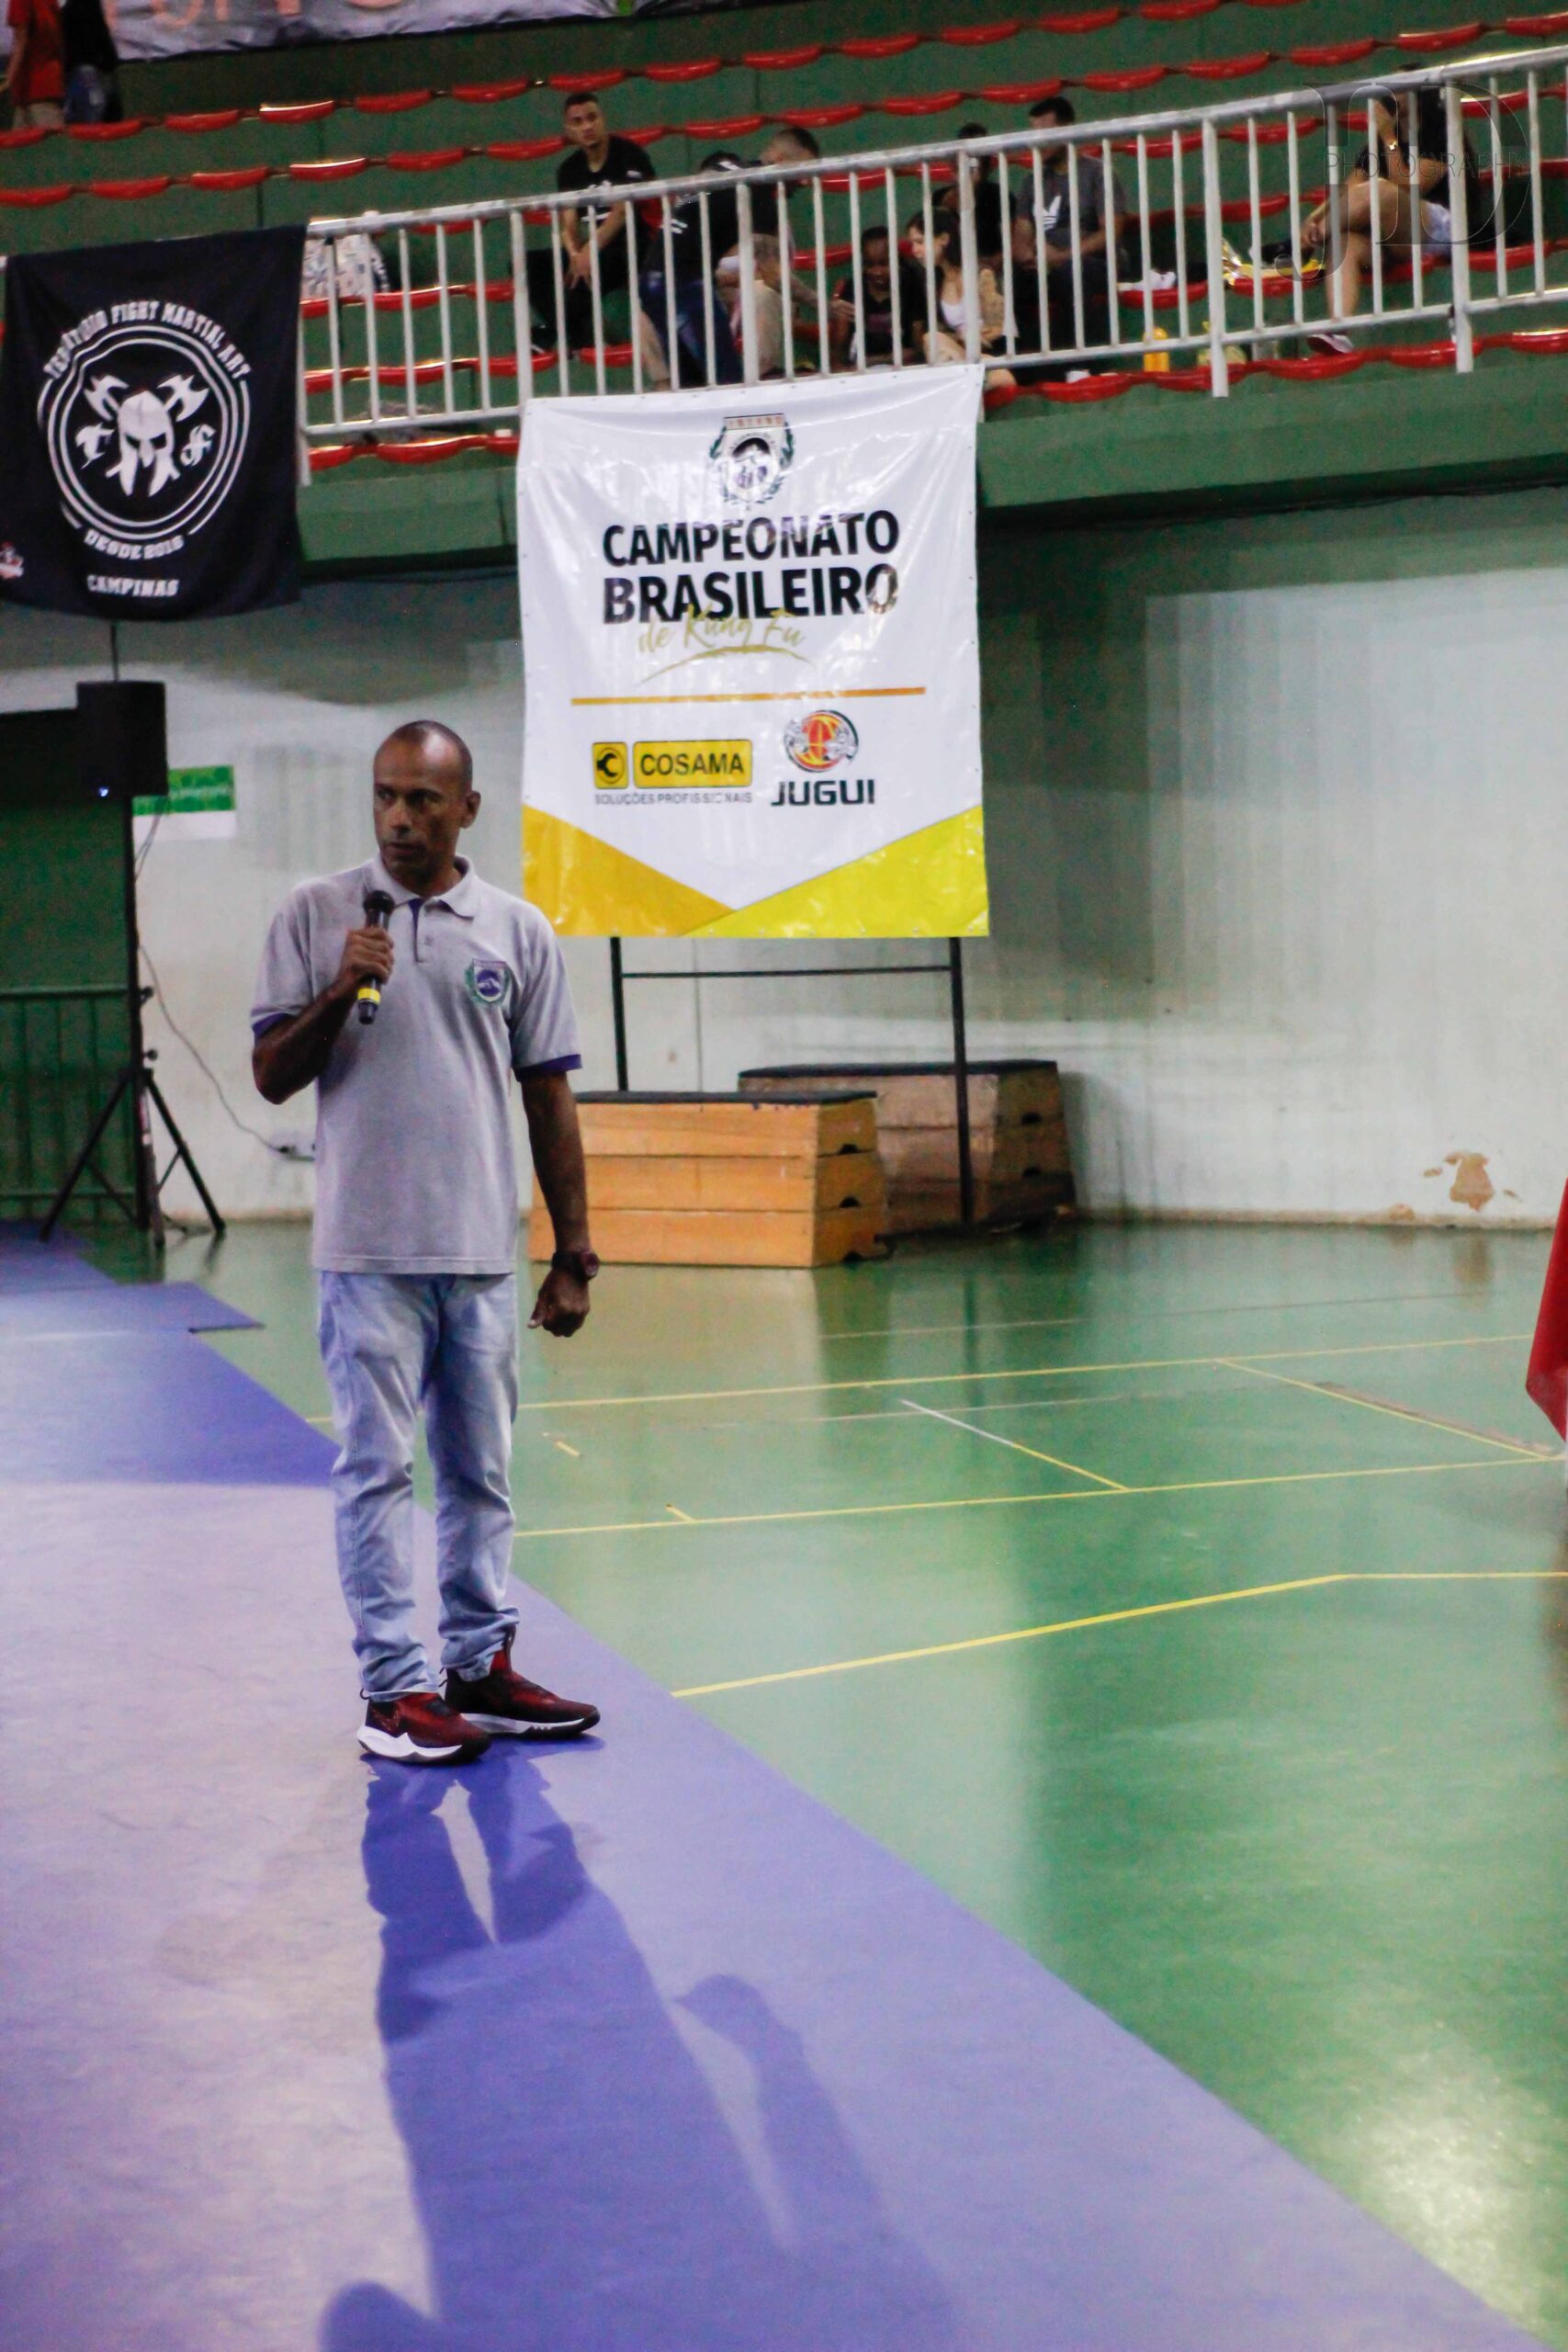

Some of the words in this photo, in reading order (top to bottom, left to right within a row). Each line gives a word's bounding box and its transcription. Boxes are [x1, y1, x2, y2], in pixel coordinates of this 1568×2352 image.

[110, 300, 160, 324] FIGHT
[159, 302, 226, 350] MARTIAL
[216, 344, 251, 379] ART
[84, 528, 142, 560] DESDE
[603, 510, 899, 567] CAMPEONATO
[87, 574, 179, 597] CAMPINAS
[603, 563, 898, 624] BRASILEIRO
[638, 616, 673, 653] de
[684, 602, 755, 648] Kung
[761, 607, 807, 647] Fu
[639, 752, 745, 776] COSAMA
[594, 792, 655, 806] SOLUÇÕES
[771, 779, 875, 806] JUGUI
